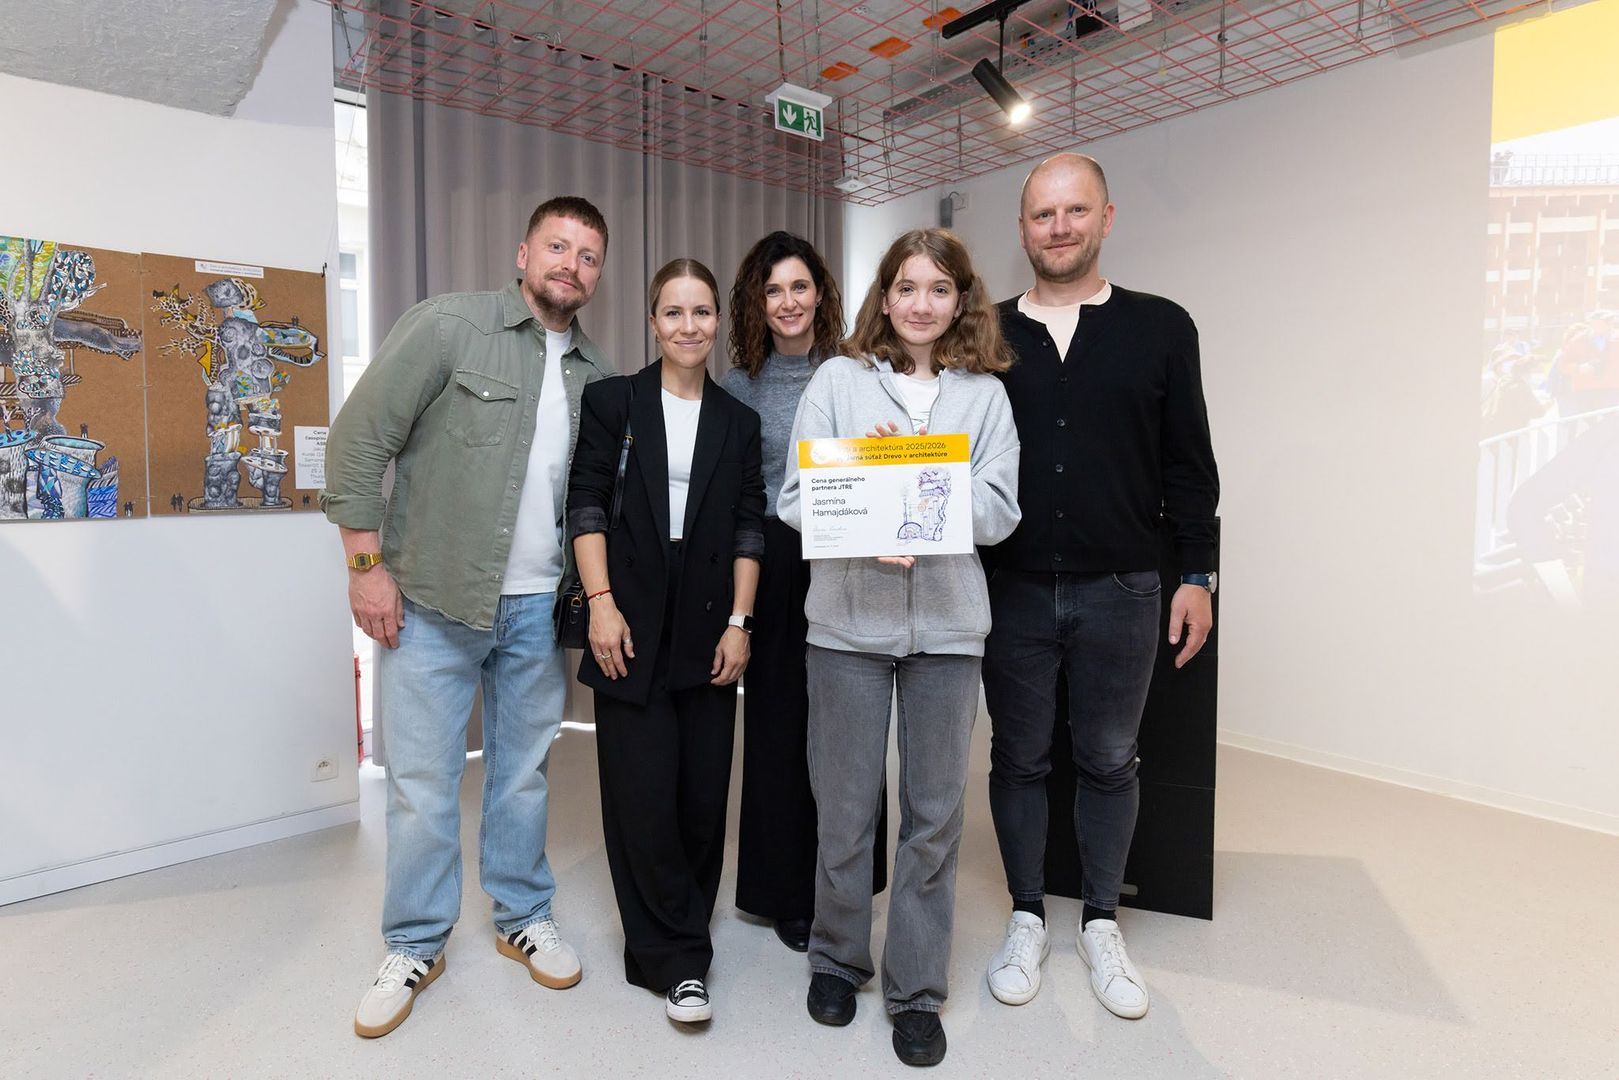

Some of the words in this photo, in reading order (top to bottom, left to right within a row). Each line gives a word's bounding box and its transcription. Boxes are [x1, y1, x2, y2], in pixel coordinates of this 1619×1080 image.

[859, 444, 904, 453] architektúra
[906, 441, 946, 450] 2025/2026
[828, 476, 866, 484] generálneho
[812, 496, 846, 506] Jasmína
[812, 506, 868, 518] Hamajdáková
